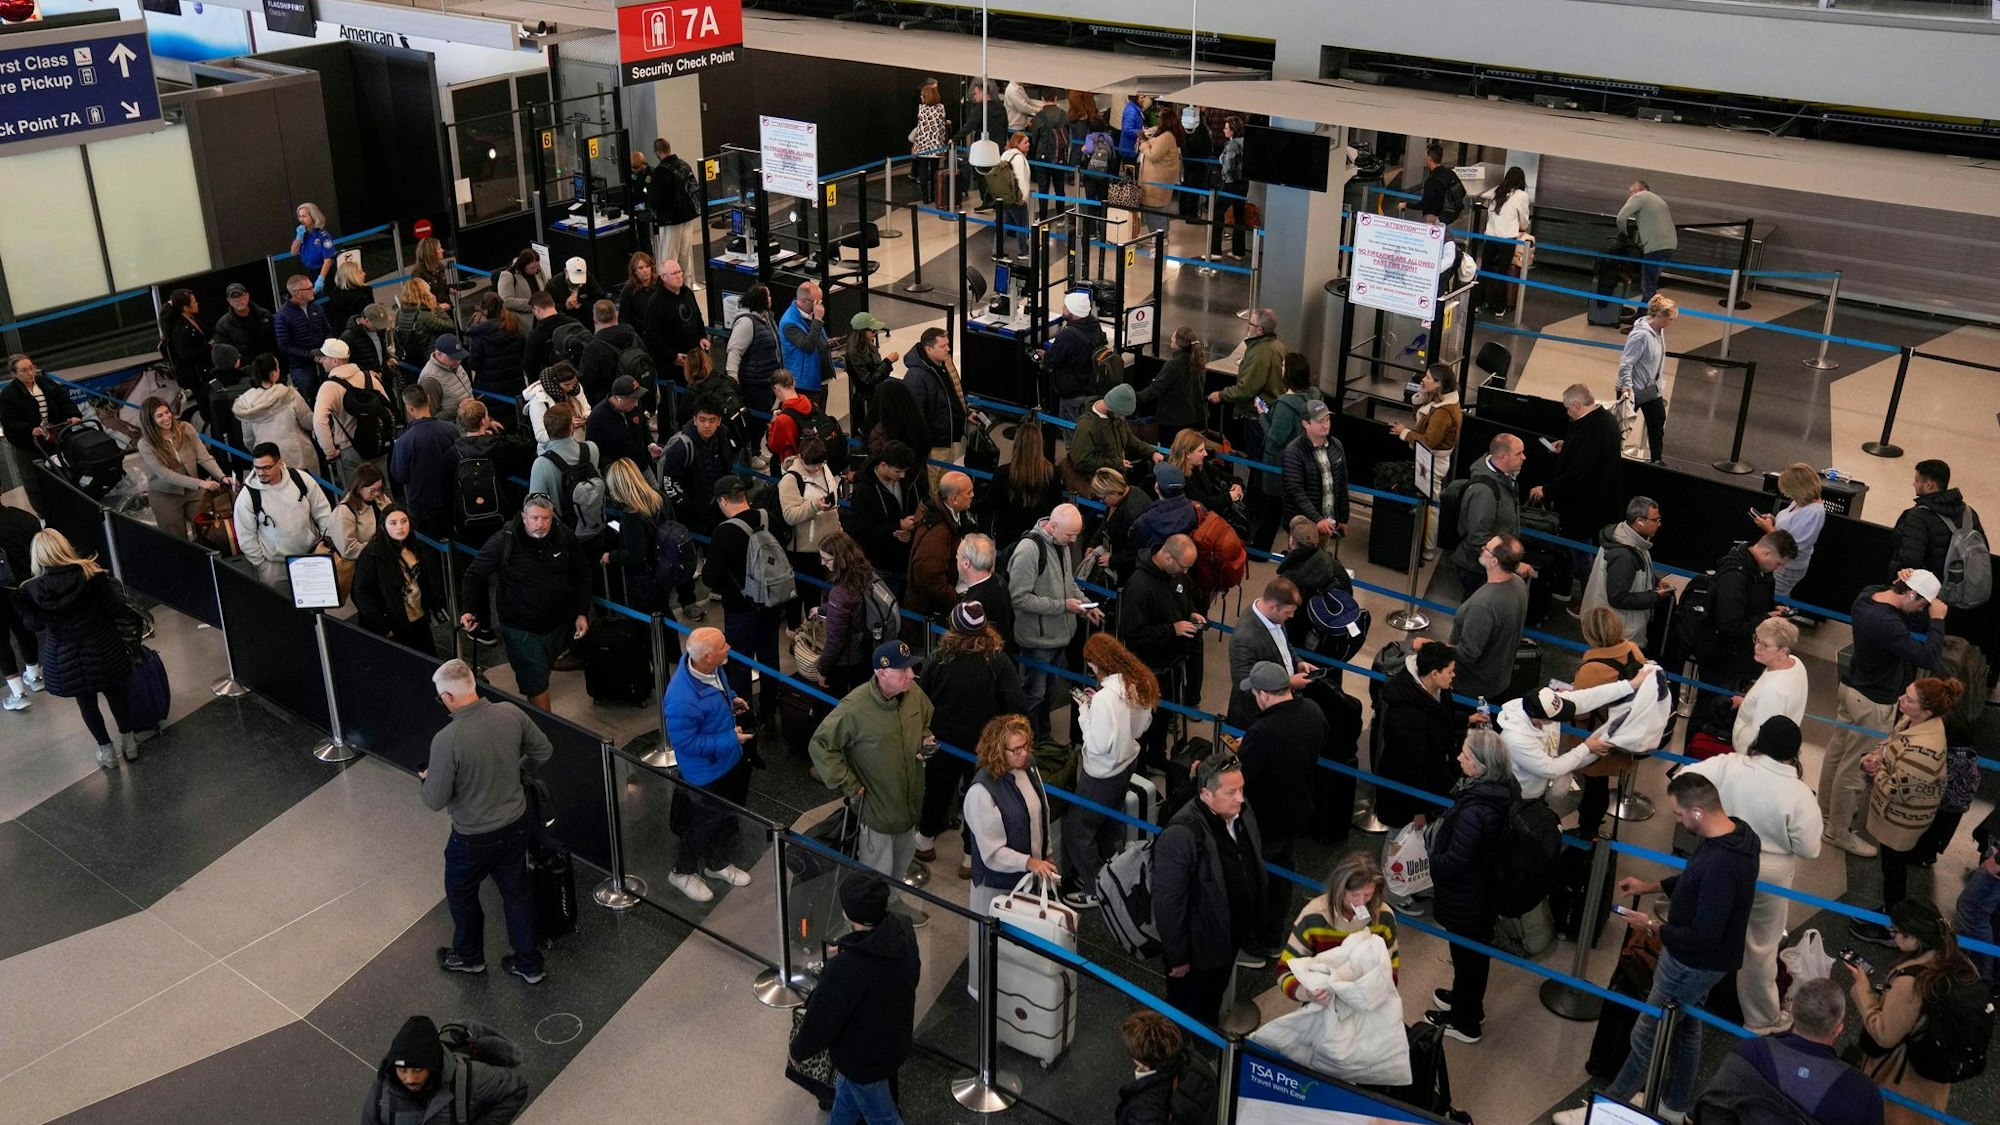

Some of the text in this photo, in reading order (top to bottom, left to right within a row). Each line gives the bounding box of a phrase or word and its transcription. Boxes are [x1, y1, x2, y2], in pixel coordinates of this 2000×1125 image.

[681, 6, 720, 40] 7A
[339, 24, 394, 47] American
[24, 55, 69, 71] Class
[632, 50, 735, 79] Security Check Point
[20, 75, 73, 92] Pickup
[17, 117, 58, 134] Point
[60, 111, 82, 127] 7A
[544, 134, 550, 146] 6
[590, 144, 597, 156] 6
[707, 166, 714, 179] 5
[828, 191, 834, 203] 4
[1128, 251, 1133, 266] 2
[1367, 250, 1394, 260] FIREARMS
[1407, 258, 1435, 268] ALLOWED
[1373, 258, 1418, 273] PAST THIS POINT
[1250, 1061, 1299, 1089] TSA Pre
[1250, 1075, 1306, 1101] Travel With Ease
